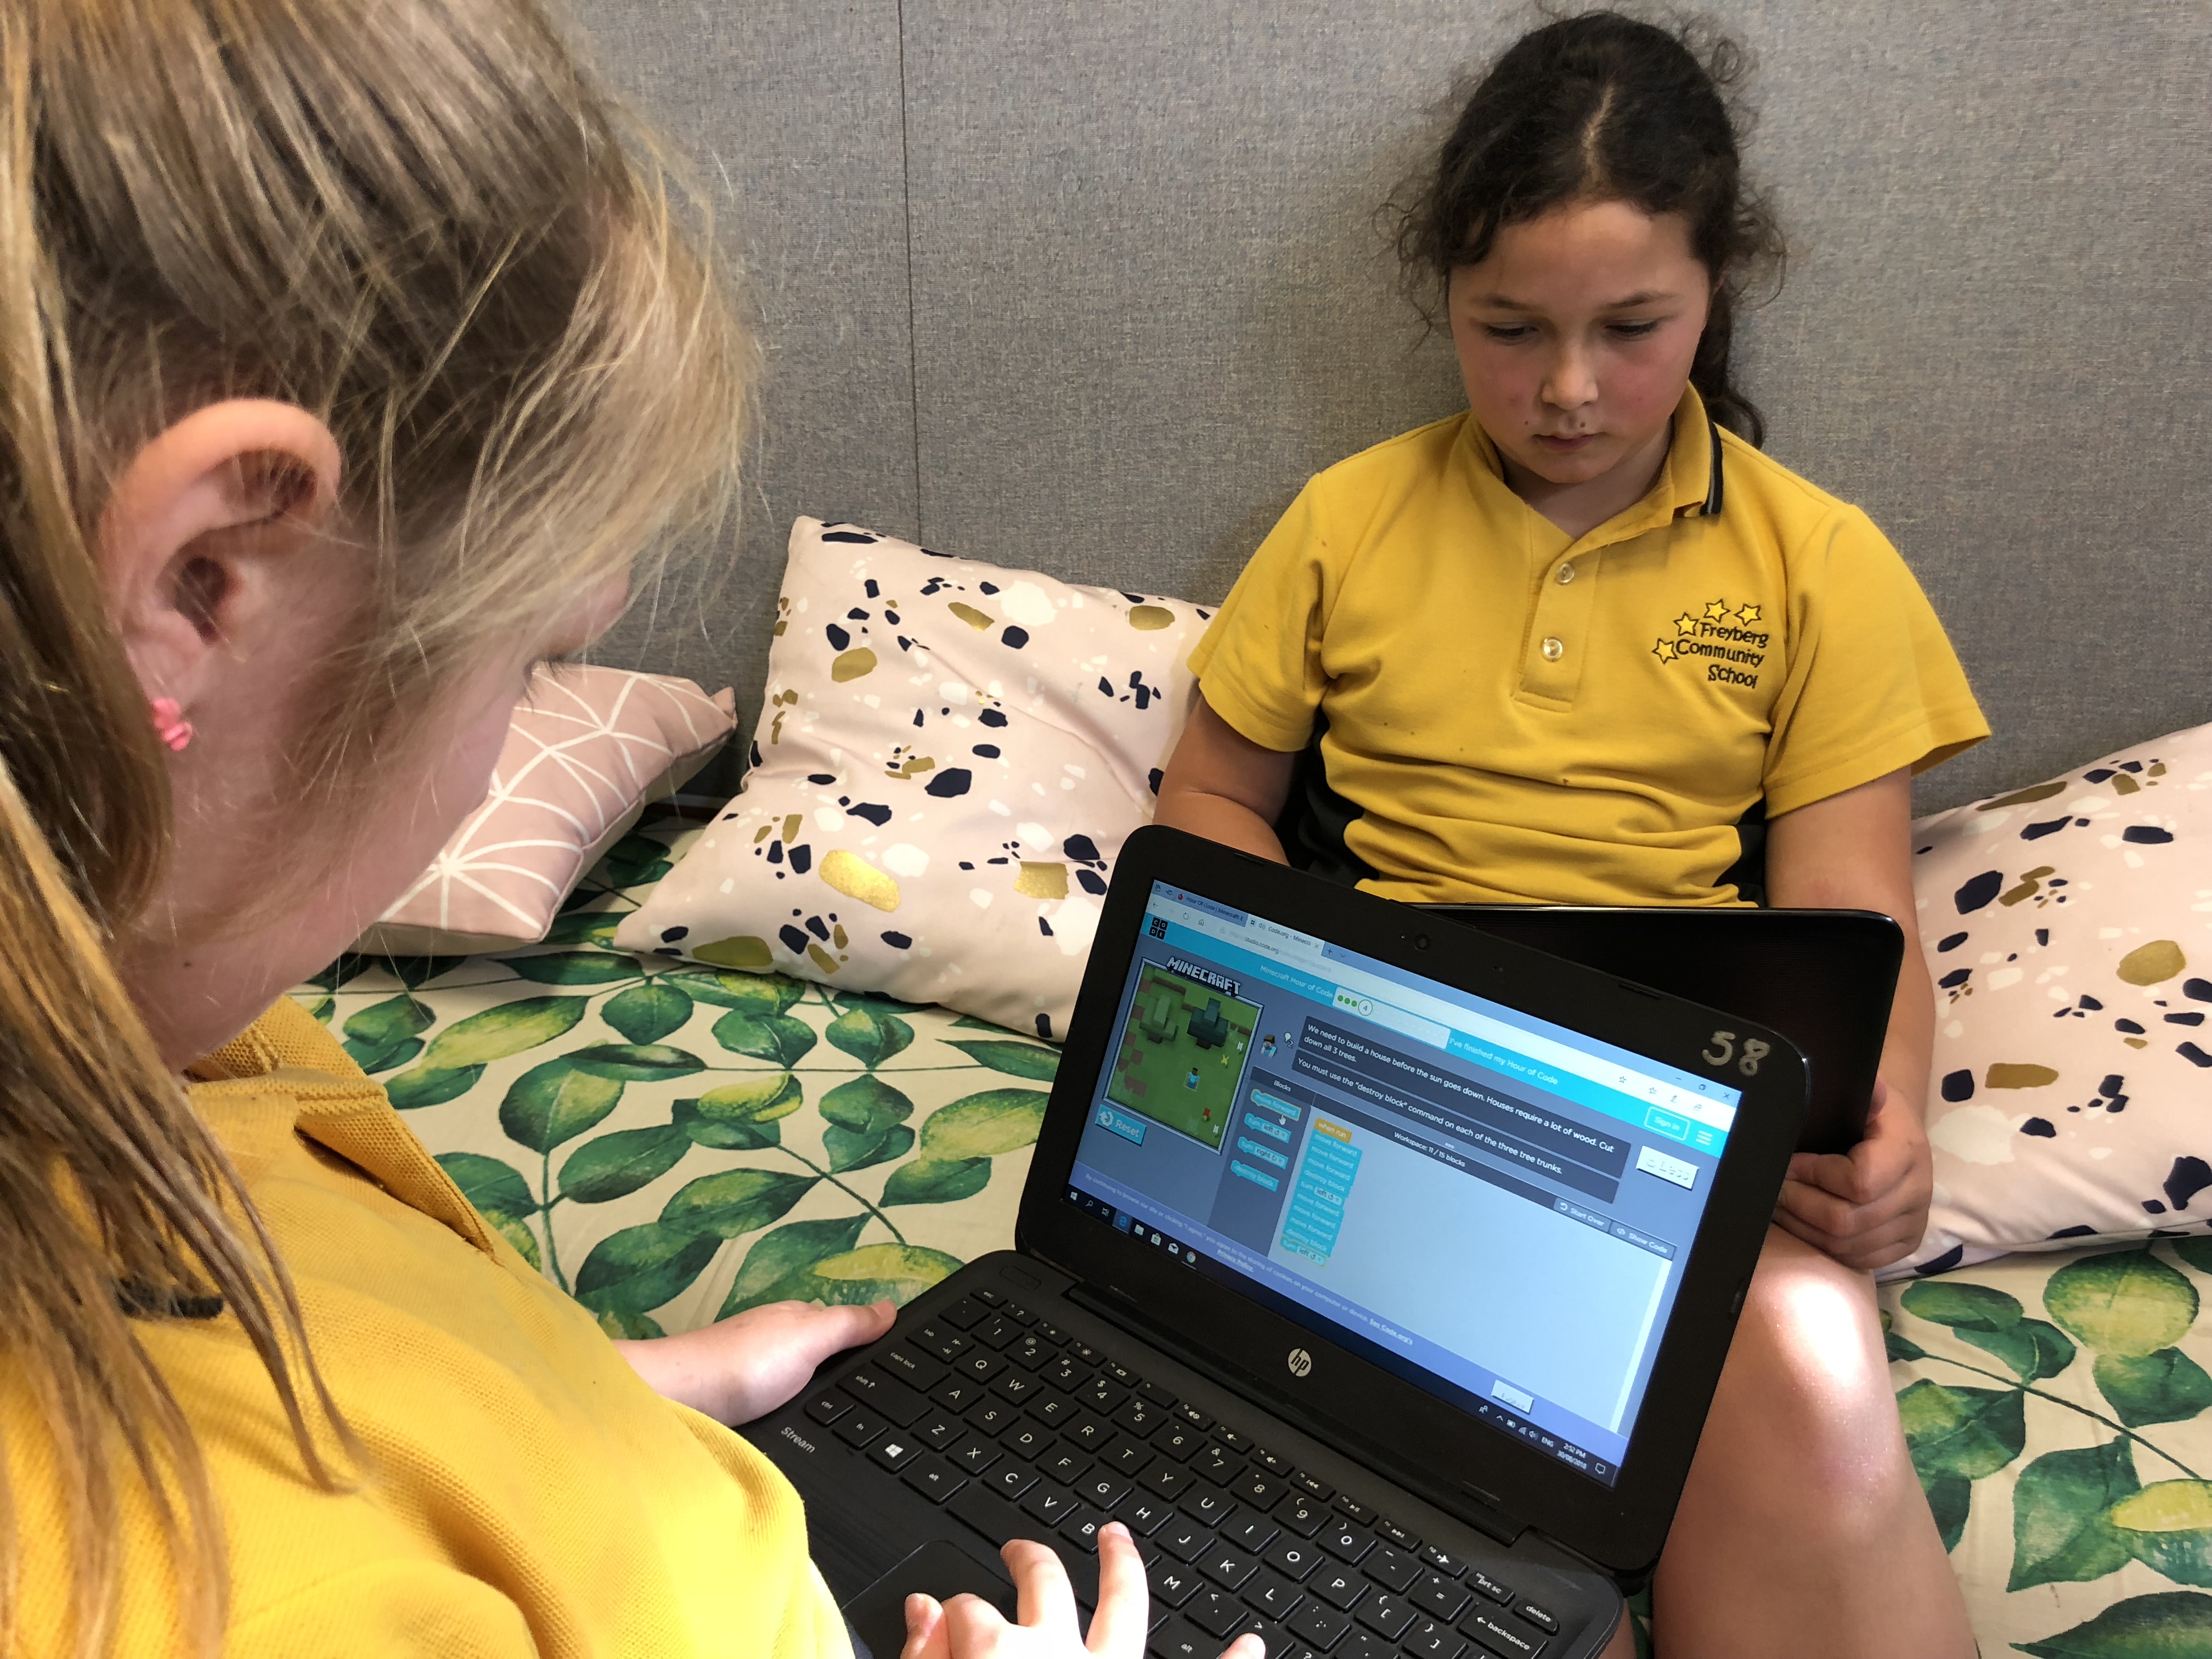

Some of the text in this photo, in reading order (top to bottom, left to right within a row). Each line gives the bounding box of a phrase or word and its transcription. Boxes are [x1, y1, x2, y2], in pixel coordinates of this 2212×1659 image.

[1700, 622, 1769, 648] Freyberg
[1675, 639, 1765, 668] Community
[1708, 664, 1758, 689] School
[1268, 926, 1289, 939] Code.org
[1166, 957, 1241, 995] MINECRAFT
[1260, 965, 1289, 981] Minecraft
[1291, 977, 1307, 988] Hour
[1316, 986, 1334, 998] Code
[1288, 1040, 1294, 1048] 2
[1304, 1035, 1322, 1048] down
[1323, 1041, 1332, 1052] all
[1338, 1048, 1357, 1063] trees.
[1702, 1030, 1770, 1076] 58
[1449, 1037, 1462, 1048] I've
[1464, 1043, 1493, 1059] finished
[1494, 1055, 1505, 1065] my
[1508, 1059, 1526, 1072] Hour
[1537, 1071, 1558, 1085] Code
[1273, 1080, 1291, 1092] Blocks
[1308, 1024, 1319, 1034] We
[1319, 1029, 1337, 1041] need
[1338, 1036, 1345, 1045] to
[1346, 1039, 1364, 1052] build
[1370, 1049, 1391, 1063] house
[1392, 1058, 1415, 1074] before
[1417, 1067, 1429, 1079] the
[1429, 1073, 1442, 1084] sun
[1443, 1079, 1461, 1091] goes
[1463, 1087, 1485, 1101] down.
[1486, 1096, 1514, 1113] Houses
[1515, 1108, 1543, 1124] require
[1550, 1121, 1562, 1132] lot
[1573, 1131, 1597, 1147] wood.
[1599, 1141, 1615, 1153] Cut
[1298, 1058, 1311, 1069] You
[1312, 1064, 1328, 1076] must
[1329, 1071, 1341, 1081] use
[1342, 1076, 1354, 1087] the
[1408, 1105, 1443, 1124] command
[1444, 1120, 1454, 1128] on
[1455, 1125, 1474, 1137] each
[1484, 1136, 1497, 1147] the
[1498, 1141, 1518, 1156] three
[1519, 1150, 1536, 1163] tree
[1537, 1158, 1562, 1175] trunks.
[1654, 1116, 1671, 1127] Sign
[1115, 1120, 1140, 1138] Reset
[1263, 1124, 1273, 1133] left
[1318, 1122, 1346, 1138] when run
[1256, 1149, 1271, 1160] right
[1394, 1131, 1427, 1151] Workspace:
[1446, 1153, 1465, 1167] blocks
[1316, 1188, 1327, 1197] left
[1570, 1207, 1604, 1226] Start Over
[1628, 1233, 1667, 1254] Show Code
[1299, 1248, 1310, 1257] left
[1025, 1348, 1036, 1356] 2
[975, 1360, 987, 1369] Q
[1289, 1348, 1311, 1377] hp
[1060, 1368, 1071, 1377] 3
[1008, 1379, 1025, 1391] W
[949, 1390, 961, 1400] A
[1097, 1391, 1108, 1400] 4
[1045, 1402, 1058, 1413] E
[984, 1411, 997, 1420] S
[1134, 1413, 1146, 1421] 5
[931, 1424, 946, 1435] Z
[1081, 1425, 1094, 1436] R
[781, 1426, 816, 1454] Stream
[1019, 1433, 1032, 1443] D
[1172, 1436, 1184, 1445] 6
[967, 1447, 981, 1459] X
[1122, 1448, 1134, 1459] T
[1058, 1457, 1072, 1466] F
[1212, 1459, 1224, 1467] 7
[1005, 1472, 1018, 1483] C
[1162, 1472, 1174, 1483] Y
[1097, 1482, 1110, 1493] G
[1254, 1484, 1265, 1493] 8
[1044, 1496, 1058, 1508] V
[1201, 1497, 1215, 1508] U
[1136, 1507, 1151, 1519] H
[1296, 1509, 1308, 1519] 9
[1081, 1523, 1096, 1534] B
[1178, 1536, 1192, 1544] J
[1220, 1559, 1235, 1573] K
[1164, 1575, 1181, 1590] M
[1331, 1578, 1345, 1588] P
[1265, 1588, 1274, 1601] L
[1526, 1606, 1551, 1623] delete
[1487, 1622, 1530, 1651] backspace
[1181, 1643, 1193, 1653] alt
